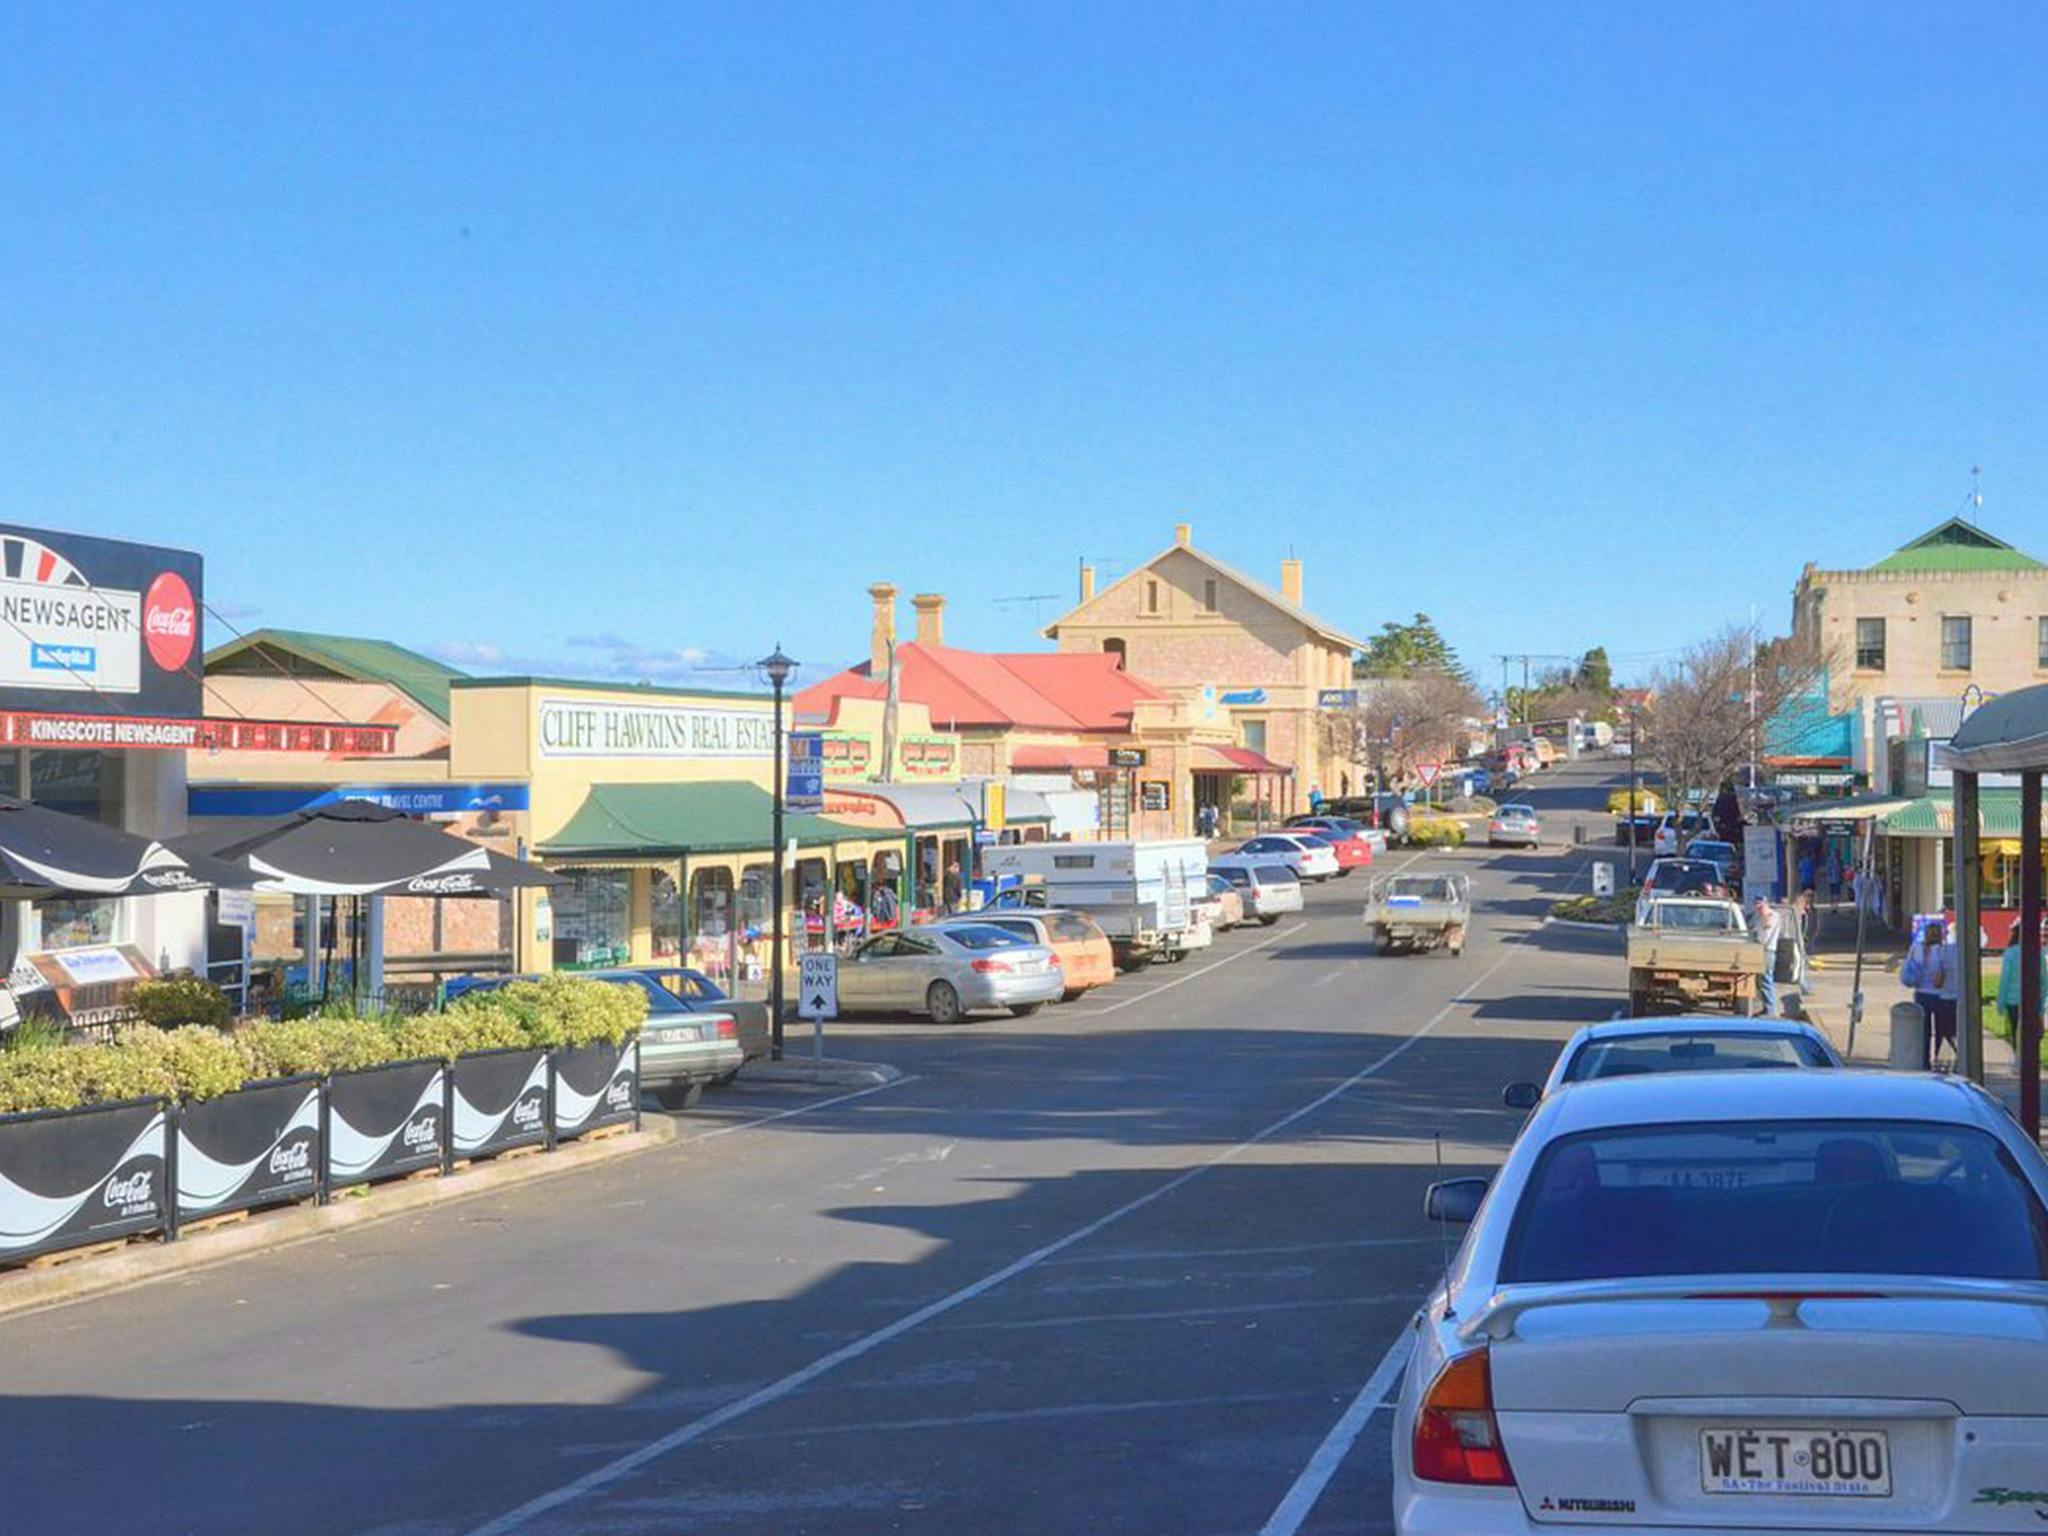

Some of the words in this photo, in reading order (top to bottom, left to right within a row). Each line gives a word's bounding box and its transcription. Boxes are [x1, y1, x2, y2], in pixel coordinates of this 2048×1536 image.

[4, 596, 131, 632] NEWSAGENT
[147, 605, 192, 636] Coca-Cola
[31, 720, 112, 742] KINGSCOTE
[114, 724, 196, 745] NEWSAGENT
[543, 710, 597, 748] CLIFF
[604, 712, 687, 749] HAWKINS
[692, 716, 731, 749] REAL
[736, 717, 778, 750] ESTAT
[806, 960, 831, 972] ONE
[804, 976, 832, 987] WAY
[1707, 1435, 1790, 1478] WET
[1810, 1437, 1882, 1480] 800
[1558, 1498, 1636, 1513] MITSUBISHI
